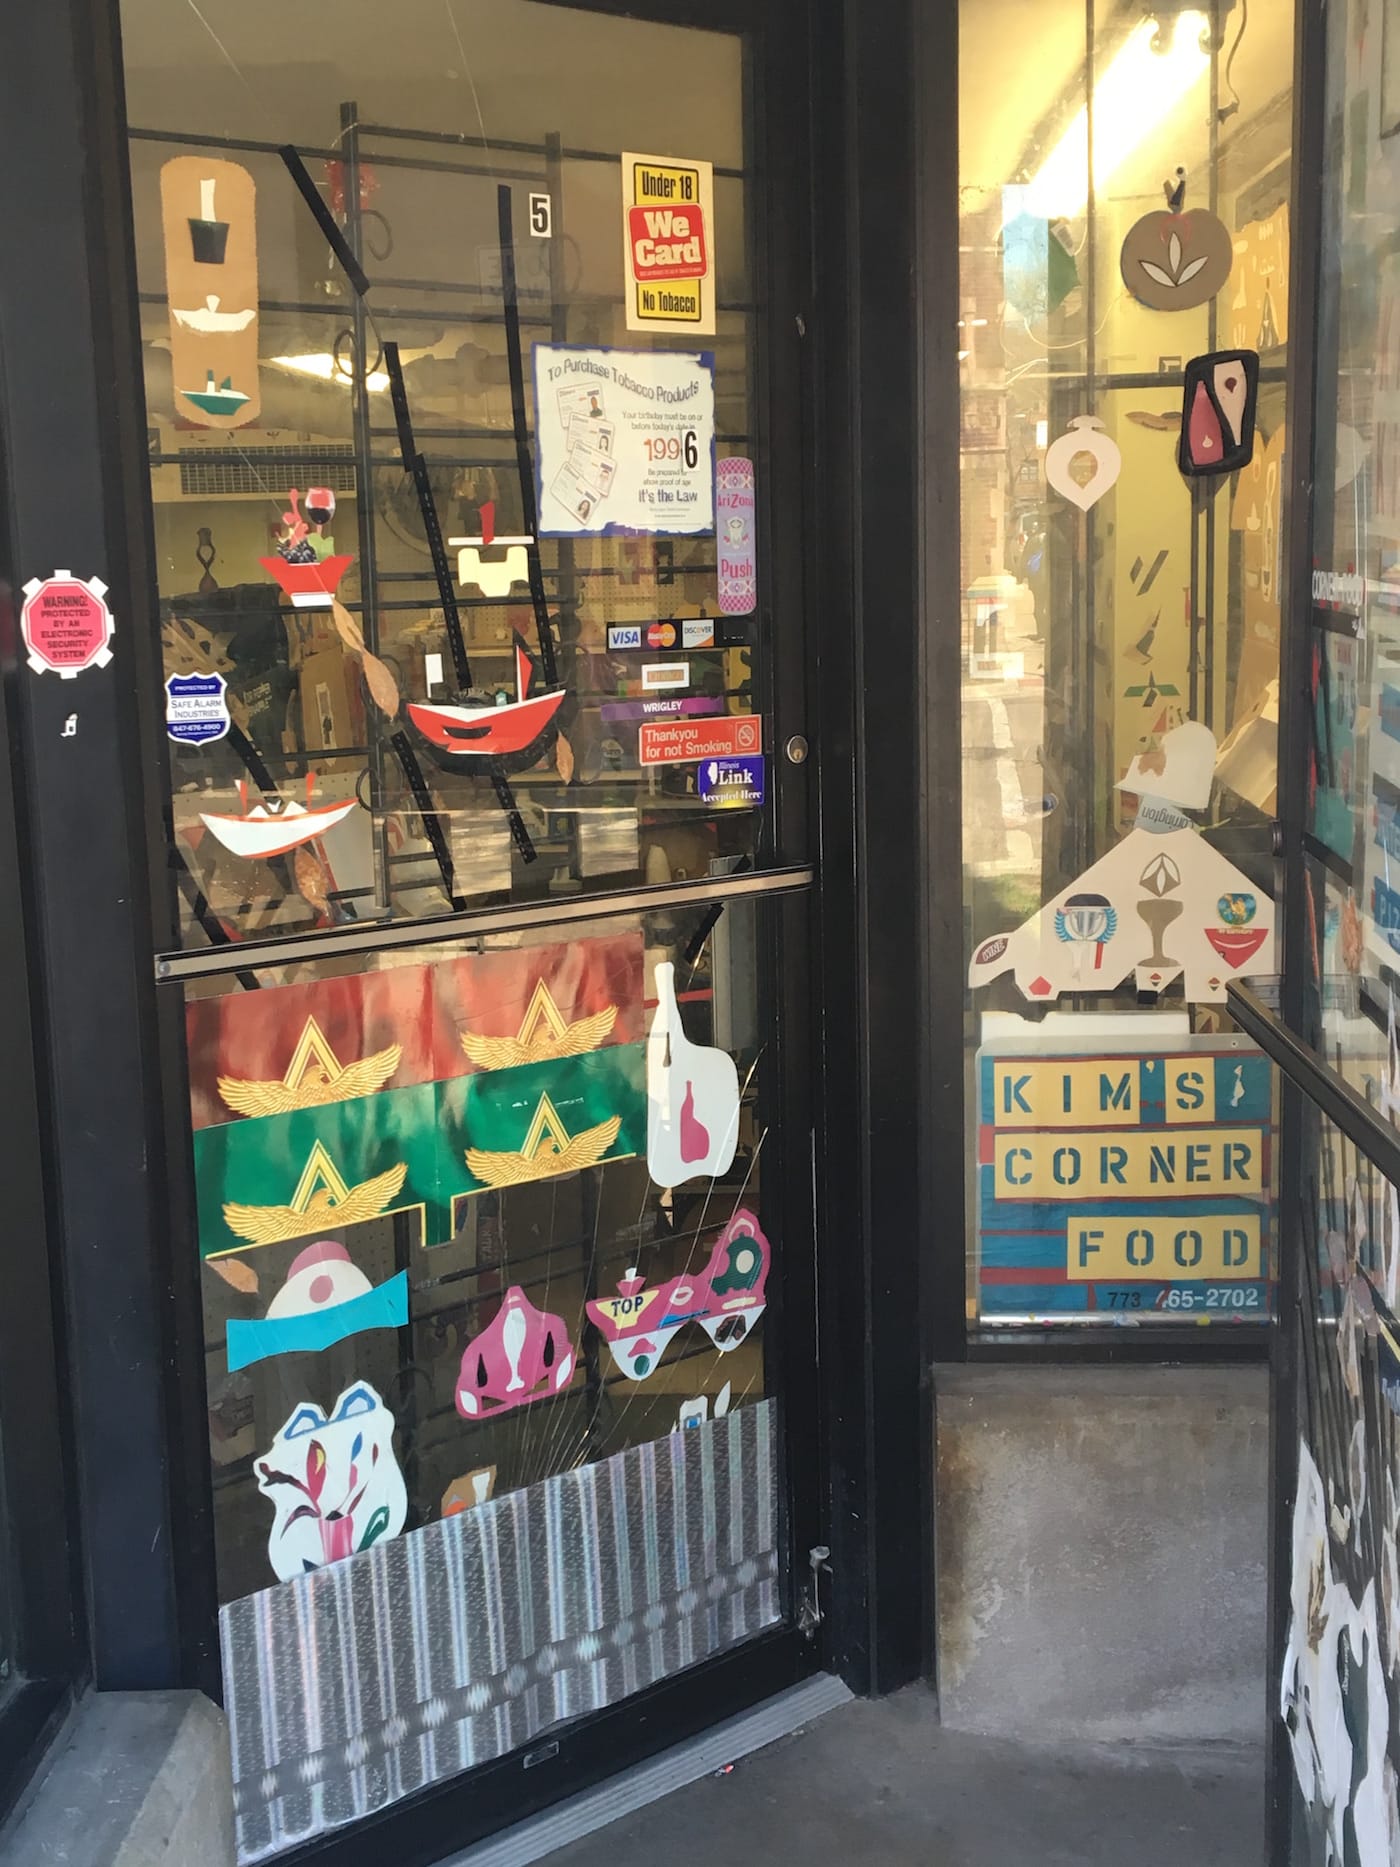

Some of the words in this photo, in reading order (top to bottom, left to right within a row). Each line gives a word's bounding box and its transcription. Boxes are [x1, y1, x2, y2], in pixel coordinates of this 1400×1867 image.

[642, 171, 676, 198] Under
[679, 175, 692, 200] 18
[532, 197, 549, 233] 5
[644, 210, 690, 239] We
[635, 236, 702, 267] Card
[643, 290, 655, 311] No
[658, 291, 696, 313] Tobacco
[548, 365, 562, 382] To
[563, 358, 610, 380] Purchase
[611, 367, 655, 400] Tobacco
[656, 380, 699, 404] Products
[622, 411, 637, 420] Your
[679, 413, 687, 421] be
[643, 430, 698, 469] 1996
[638, 488, 655, 503] It's
[657, 489, 674, 502] the
[676, 489, 698, 502] Law
[721, 558, 753, 579] Push
[41, 609, 91, 618] PROTECTED
[53, 620, 64, 628] BY
[41, 630, 93, 639] ELECTRONIC
[612, 631, 639, 644] VISA
[47, 640, 88, 649] SECURITY
[52, 650, 86, 659] SYSTEM
[643, 701, 683, 713] WRIGLEY
[646, 746, 661, 758] for
[664, 744, 682, 756] not
[686, 739, 732, 755] Smoking
[719, 769, 753, 785] Link
[702, 791, 739, 804] Accepted
[741, 790, 762, 800] Here
[1003, 1060, 1204, 1113] KIM'S
[1004, 1143, 1252, 1185] CORNER
[1079, 1229, 1249, 1267] FOOD
[611, 1296, 644, 1317] TOP
[1107, 1291, 1142, 1308] 773
